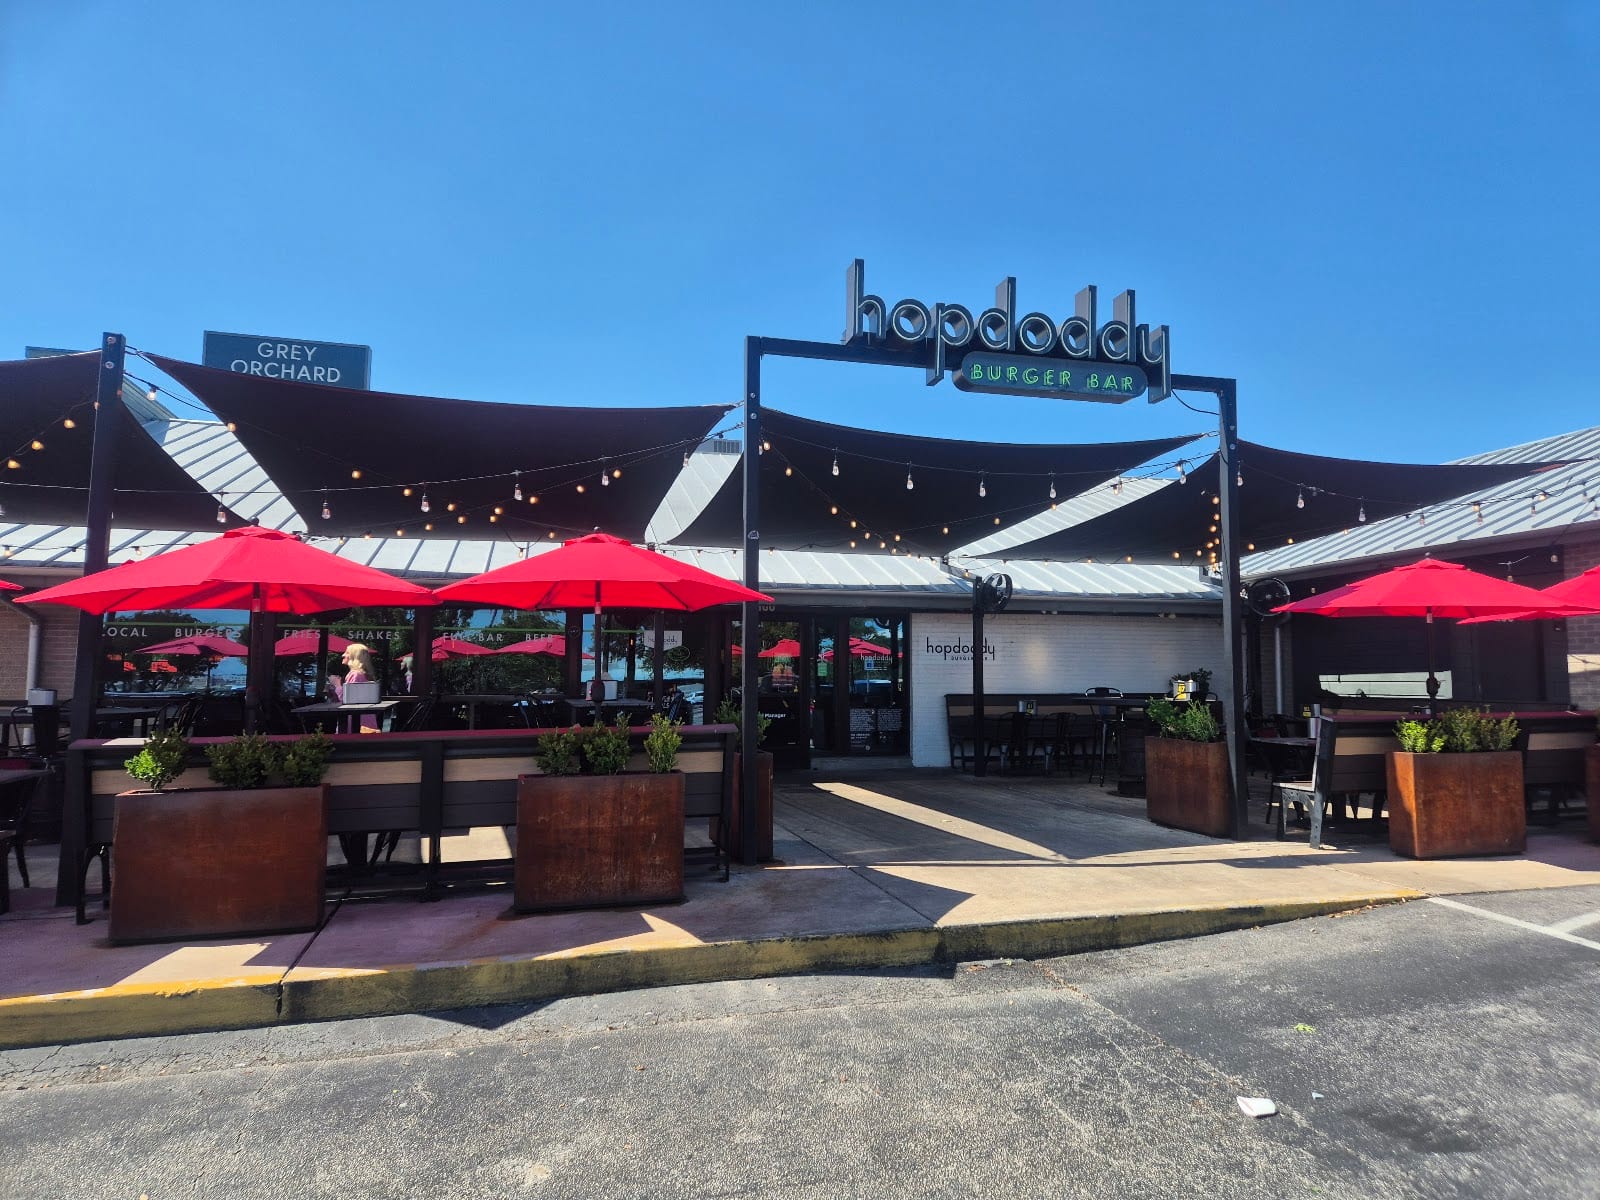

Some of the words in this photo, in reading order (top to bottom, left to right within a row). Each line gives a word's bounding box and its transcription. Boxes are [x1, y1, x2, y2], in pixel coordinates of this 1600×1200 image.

[846, 258, 1171, 404] hopdoddy
[257, 342, 317, 361] GREY
[230, 359, 341, 383] ORCHARD
[970, 363, 1072, 386] BURGER
[1086, 372, 1134, 393] BAR
[284, 629, 321, 639] FRIES
[348, 630, 401, 640] SHAKES
[478, 633, 504, 642] BAR
